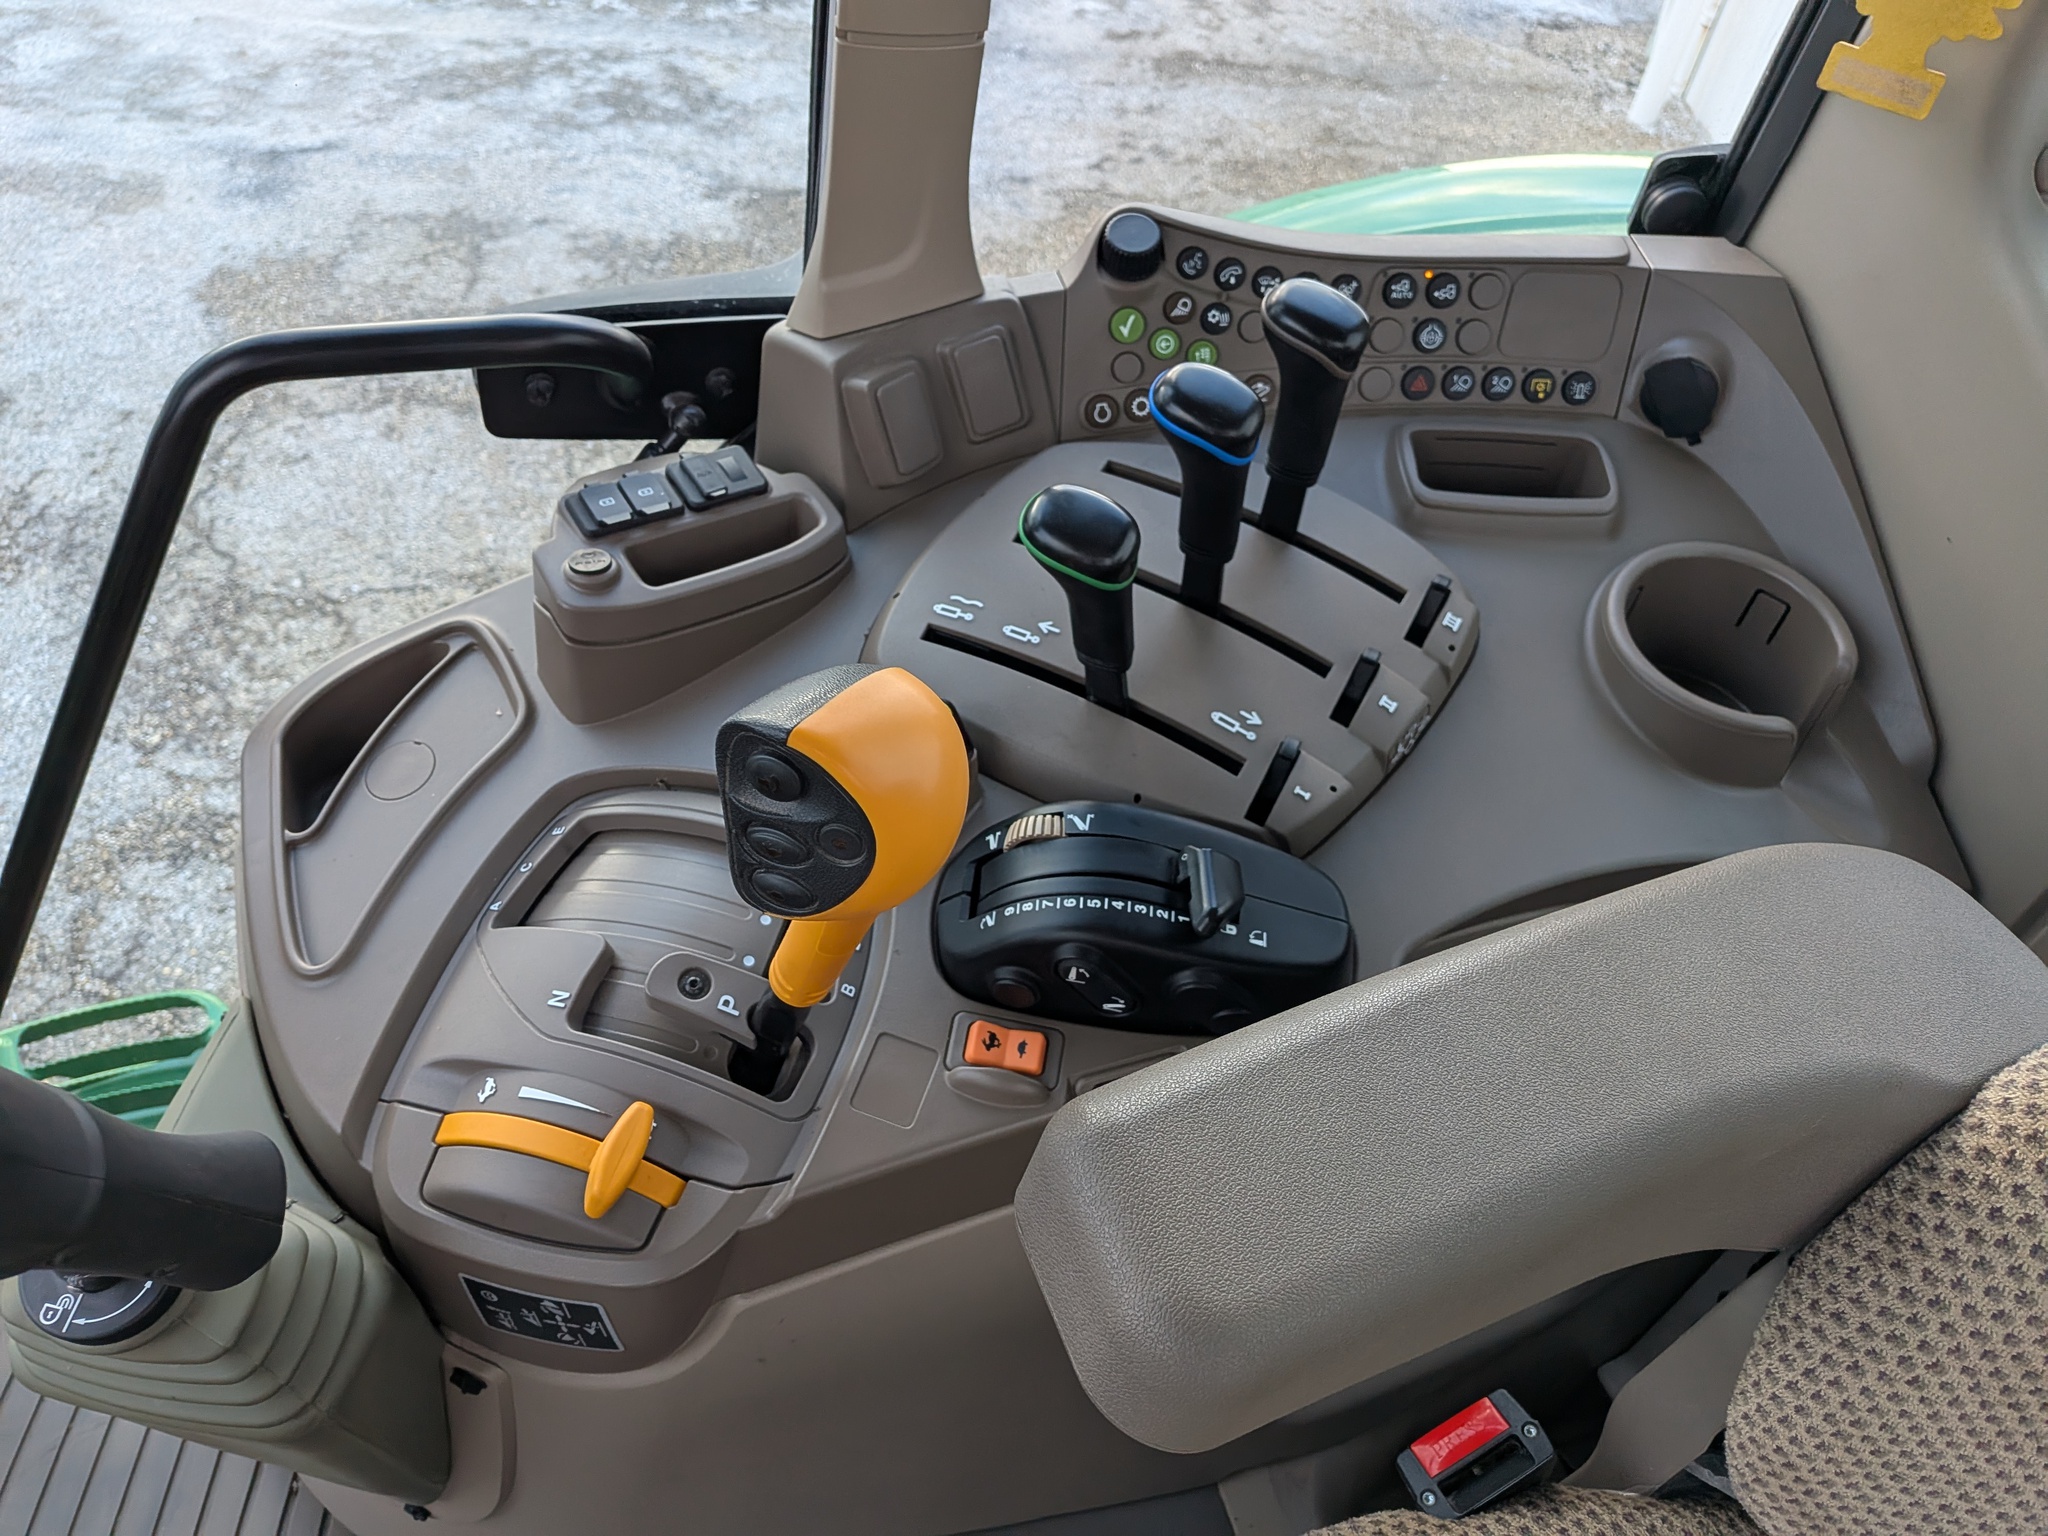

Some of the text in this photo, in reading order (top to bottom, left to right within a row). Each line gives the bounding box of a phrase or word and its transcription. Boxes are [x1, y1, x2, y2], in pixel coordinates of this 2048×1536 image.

[1391, 291, 1413, 299] AUTO
[1442, 611, 1463, 632] III
[1378, 694, 1398, 714] II
[551, 826, 566, 835] E
[520, 862, 533, 872] C
[489, 901, 503, 911] A
[1004, 898, 1191, 922] 9 8 7 6 5 4 3 2 1
[547, 989, 571, 1008] N
[840, 983, 856, 998] B
[717, 994, 741, 1017] P
[1431, 1419, 1485, 1459] PRESS
